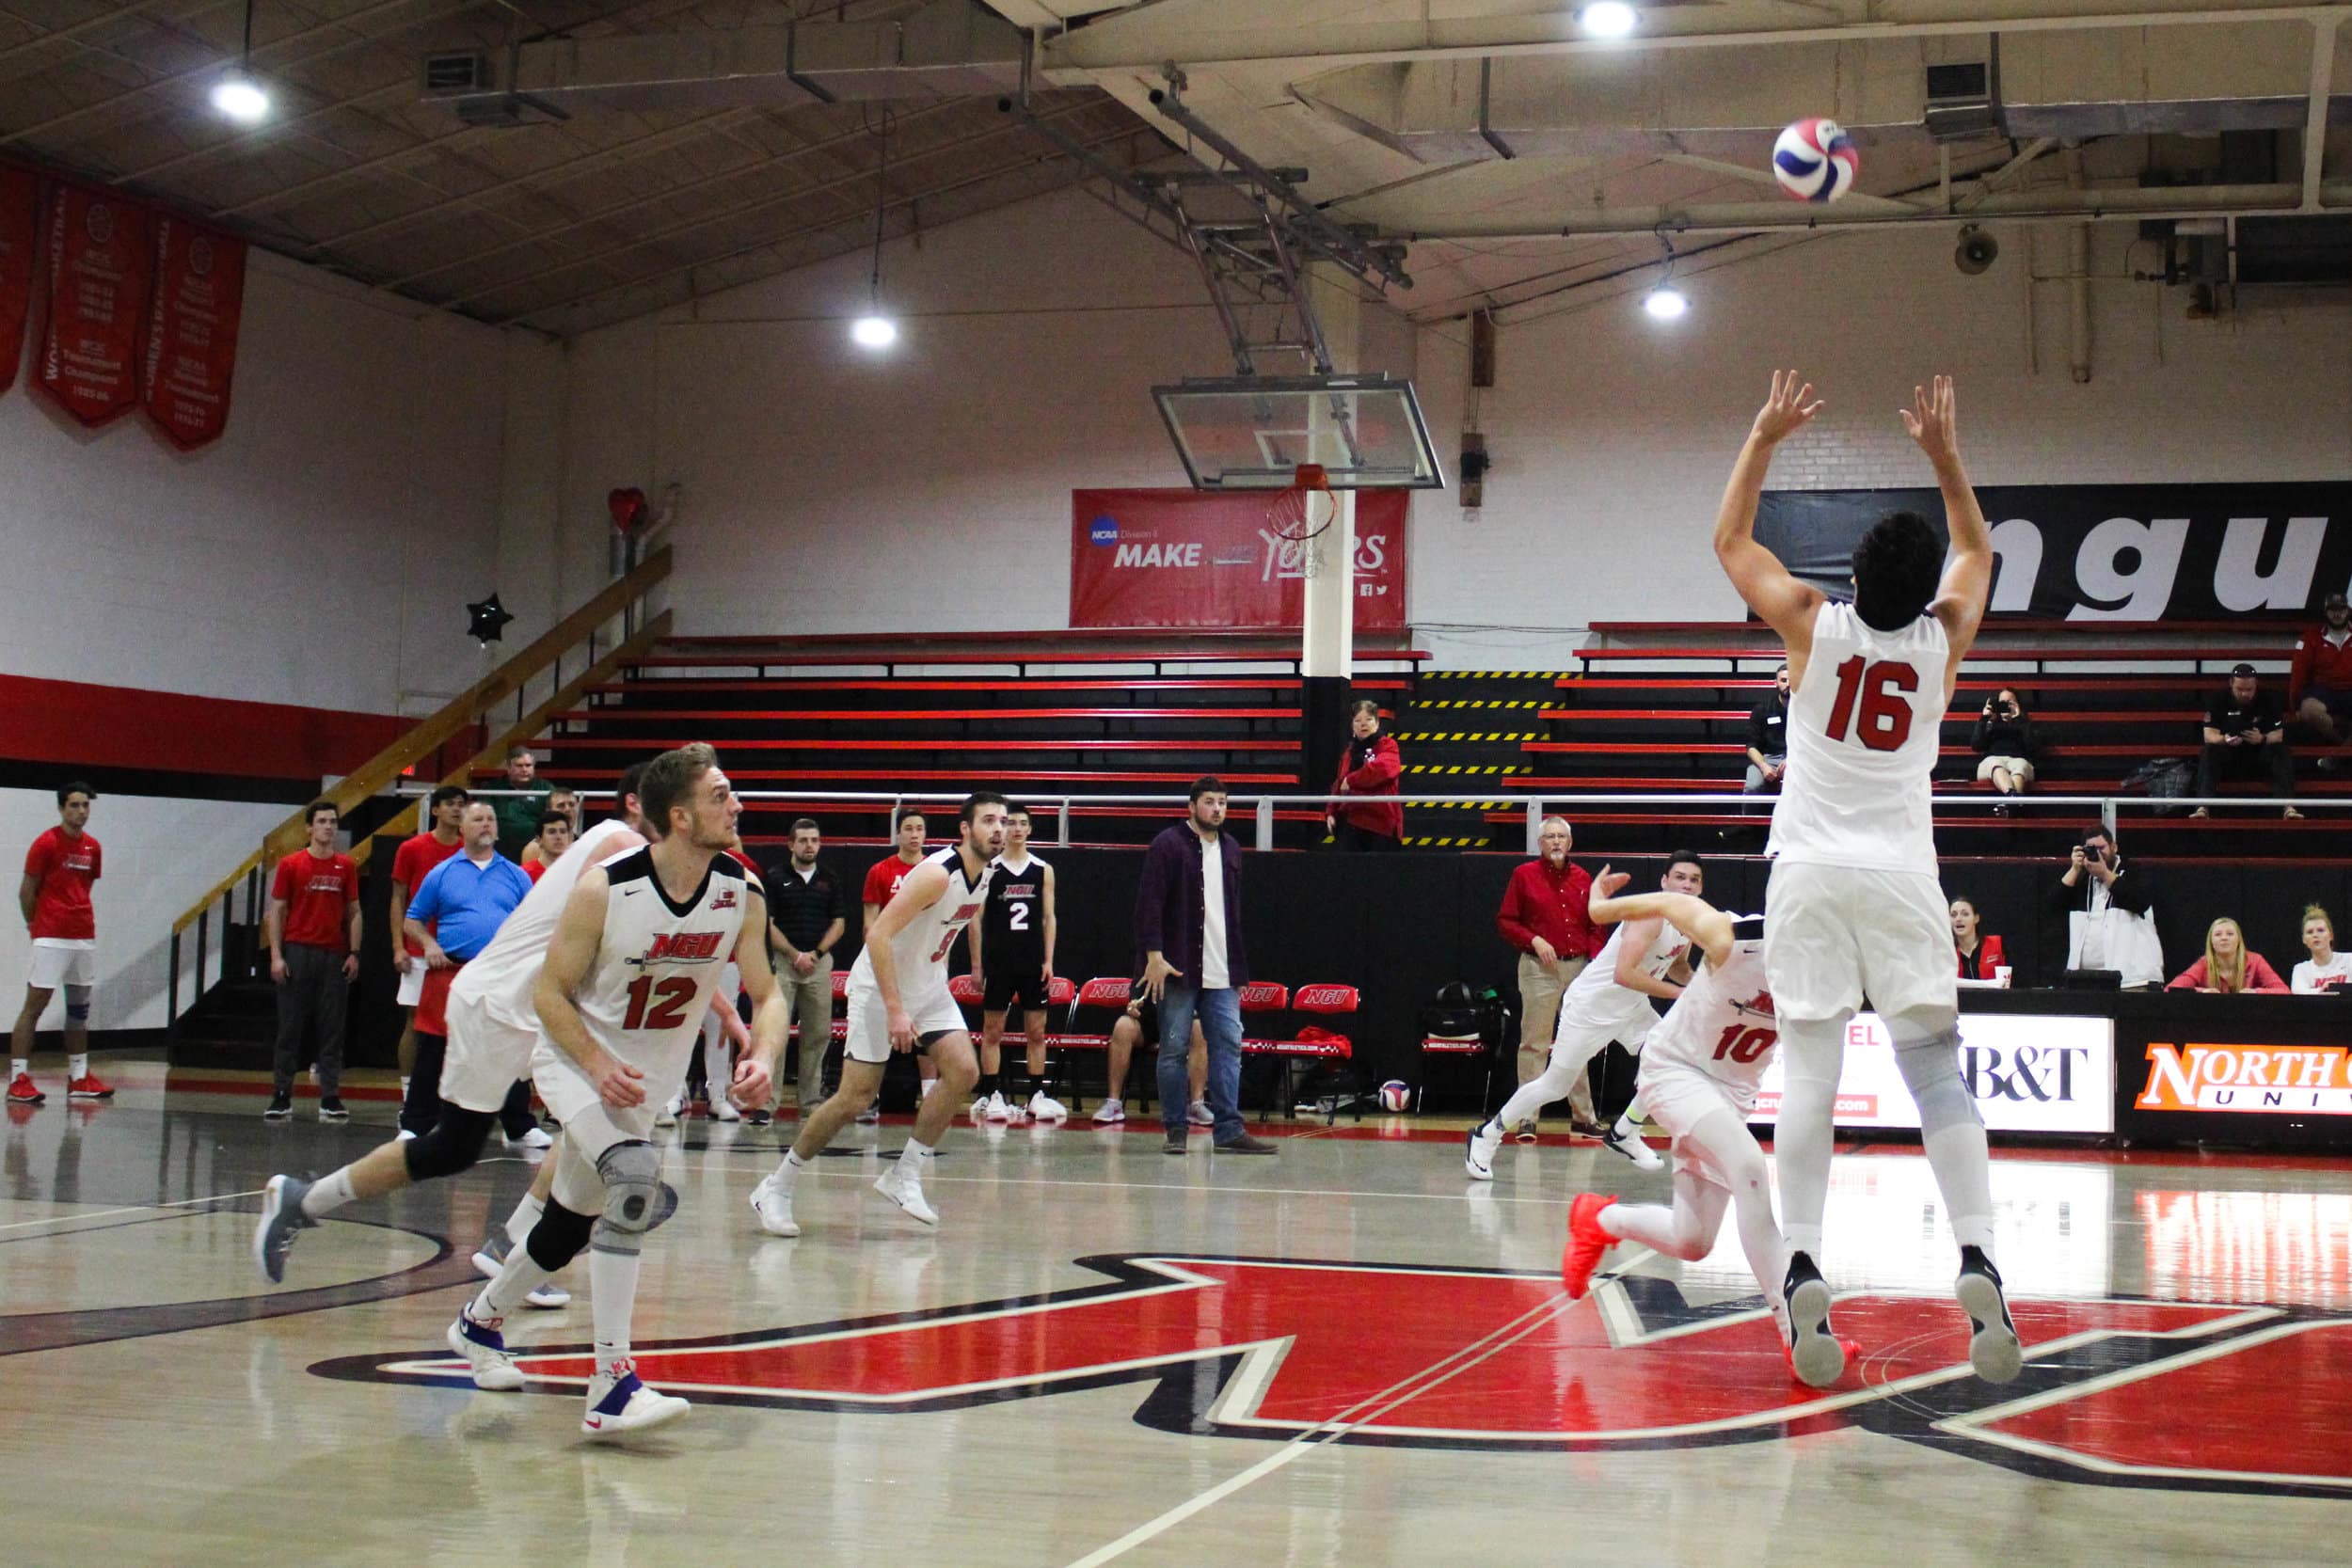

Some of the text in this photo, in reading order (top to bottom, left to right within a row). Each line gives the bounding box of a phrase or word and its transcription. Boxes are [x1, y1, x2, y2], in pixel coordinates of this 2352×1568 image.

[1091, 530, 1118, 540] NCAA
[1114, 543, 1202, 568] MAKE
[1934, 515, 2328, 622] ngu
[1825, 654, 1920, 752] 16
[1009, 902, 1029, 930] 2
[622, 975, 698, 1030] 12
[1304, 989, 1349, 1005] NGU
[1713, 1022, 1779, 1063] 10
[2141, 1048, 2340, 1106] NORTH
[2216, 1090, 2352, 1108] UNI
